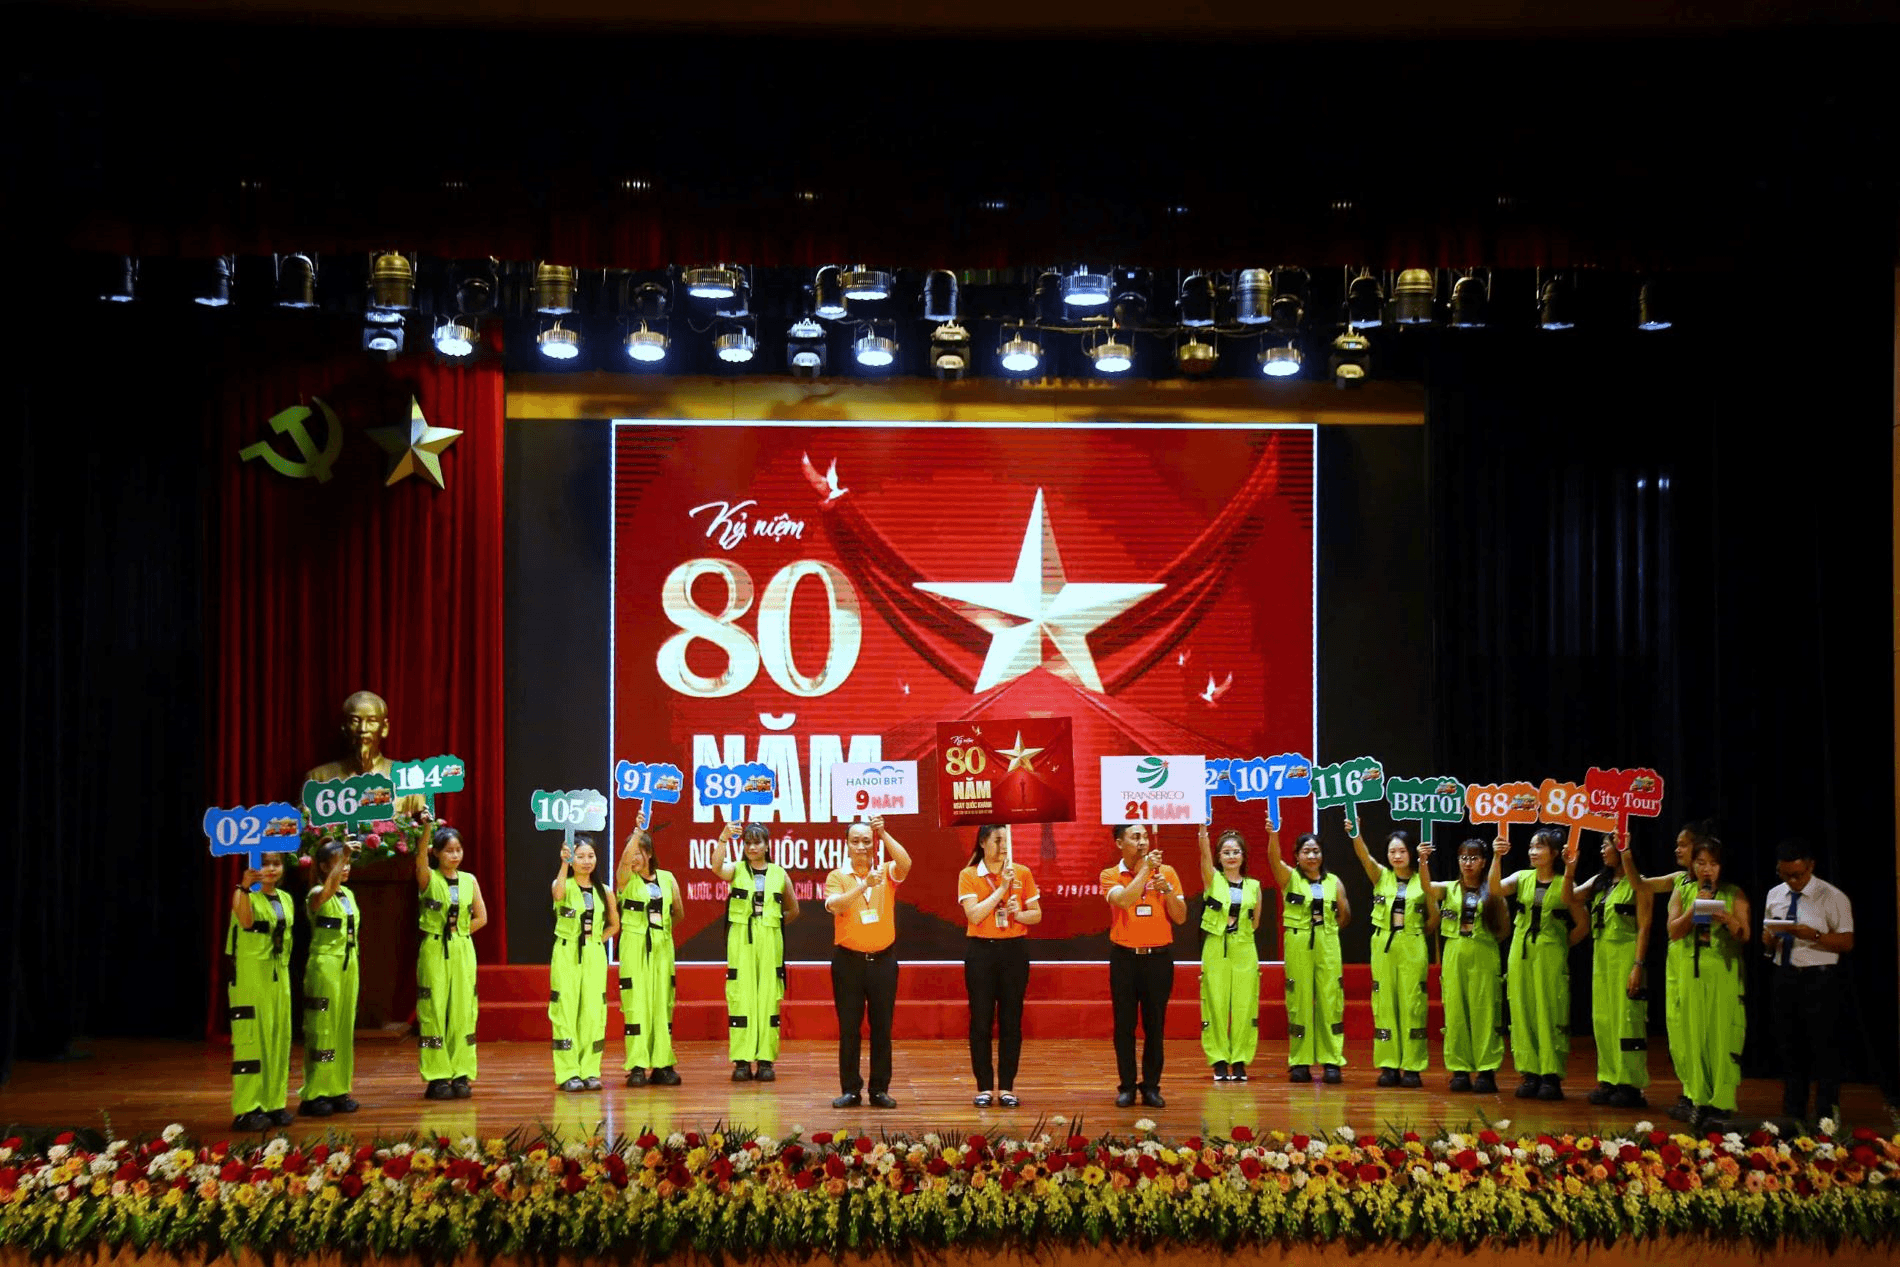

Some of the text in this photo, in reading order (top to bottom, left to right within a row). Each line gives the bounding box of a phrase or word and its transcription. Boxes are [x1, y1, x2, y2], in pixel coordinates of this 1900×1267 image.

[689, 500, 804, 550] Kỷ niệm
[656, 558, 862, 698] 80
[945, 746, 986, 776] 80
[623, 769, 652, 794] 91
[704, 774, 743, 799] 89
[846, 777, 904, 787] HANOI BRT
[953, 777, 991, 800] NĂM
[1236, 765, 1287, 792] 107
[1315, 769, 1363, 800] 116
[315, 787, 358, 817] 66
[856, 790, 869, 810] 9
[1121, 791, 1184, 800] TRANSERCO
[1392, 792, 1464, 815] BRT01
[1475, 792, 1509, 816] 68
[1546, 788, 1588, 820] 86
[1591, 789, 1659, 810] City Tour
[537, 798, 584, 824] 105
[1125, 801, 1148, 820] 21
[216, 816, 261, 846] 02
